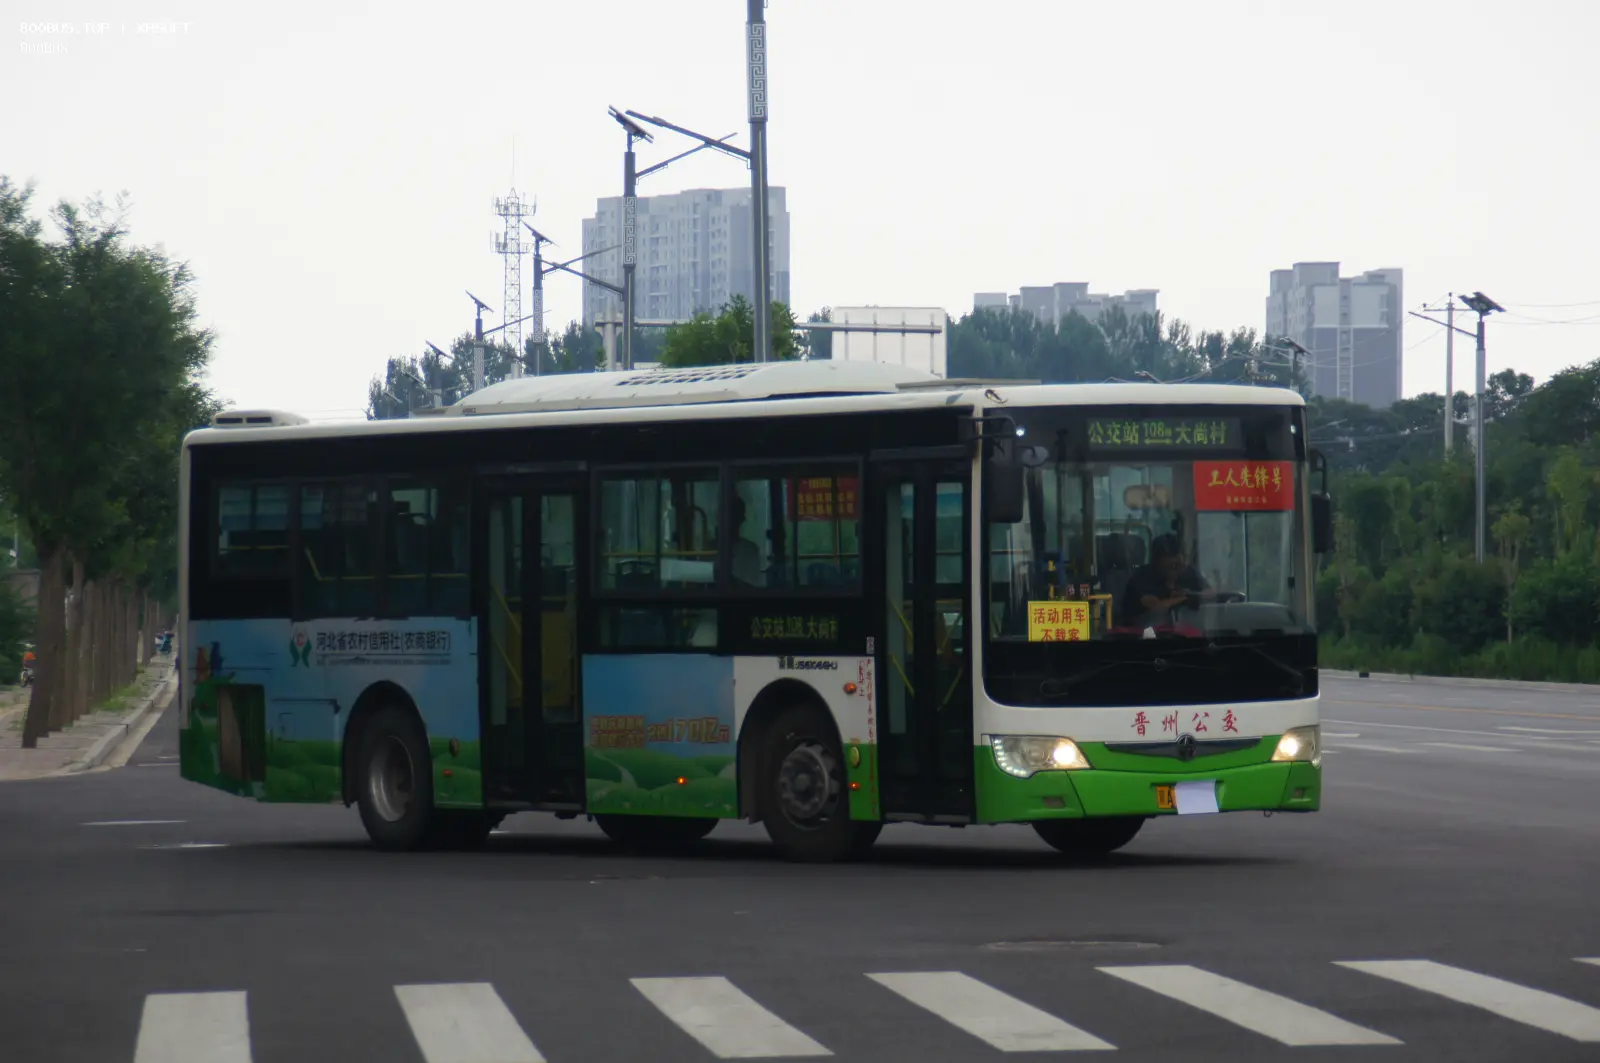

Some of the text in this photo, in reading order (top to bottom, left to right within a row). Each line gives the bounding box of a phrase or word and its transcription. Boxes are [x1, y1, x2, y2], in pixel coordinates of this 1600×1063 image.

[1207, 464, 1283, 492] 工人先锋号
[1033, 607, 1086, 625] 活动用车
[1040, 627, 1080, 641] 不载客
[1131, 709, 1239, 736] 晋州公交
